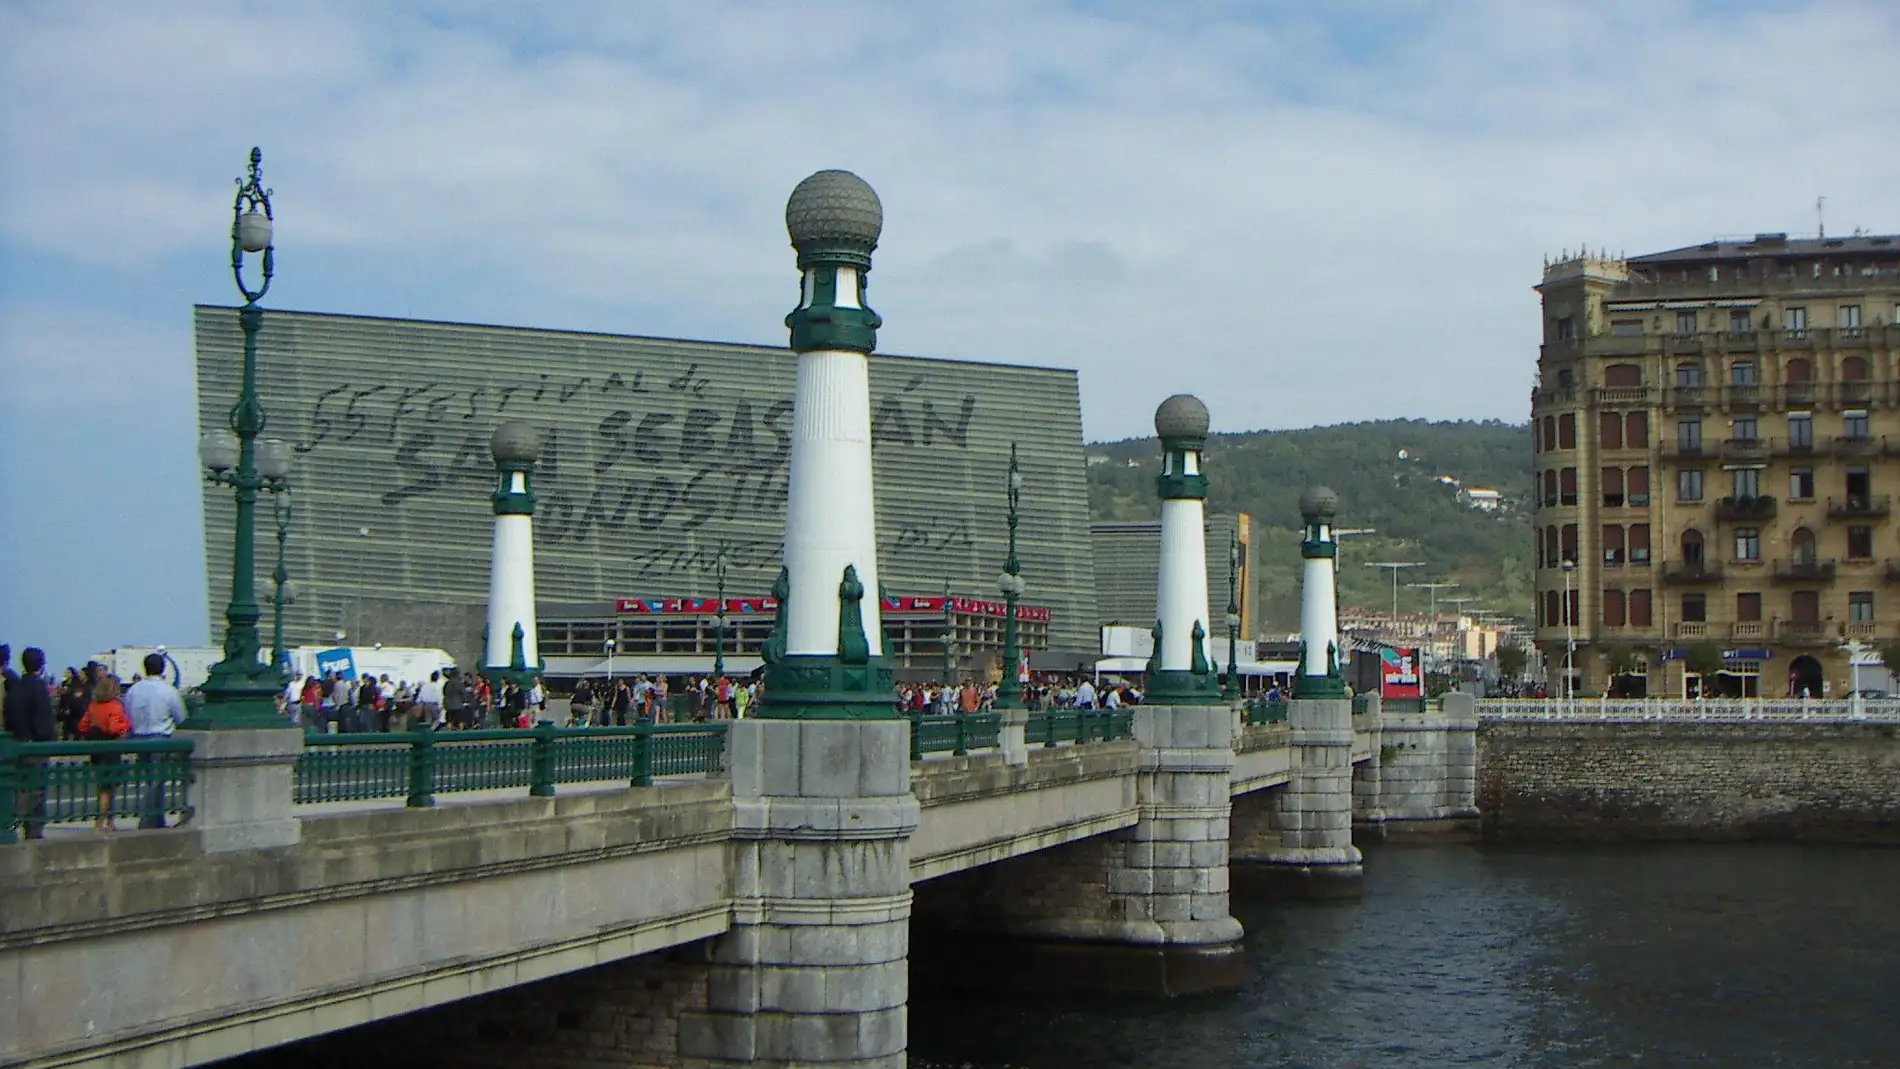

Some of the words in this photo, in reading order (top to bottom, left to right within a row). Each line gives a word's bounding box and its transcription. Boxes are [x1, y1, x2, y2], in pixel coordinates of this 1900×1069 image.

[293, 383, 386, 453] 55
[668, 364, 710, 398] de
[594, 374, 975, 472] SEBASÁN
